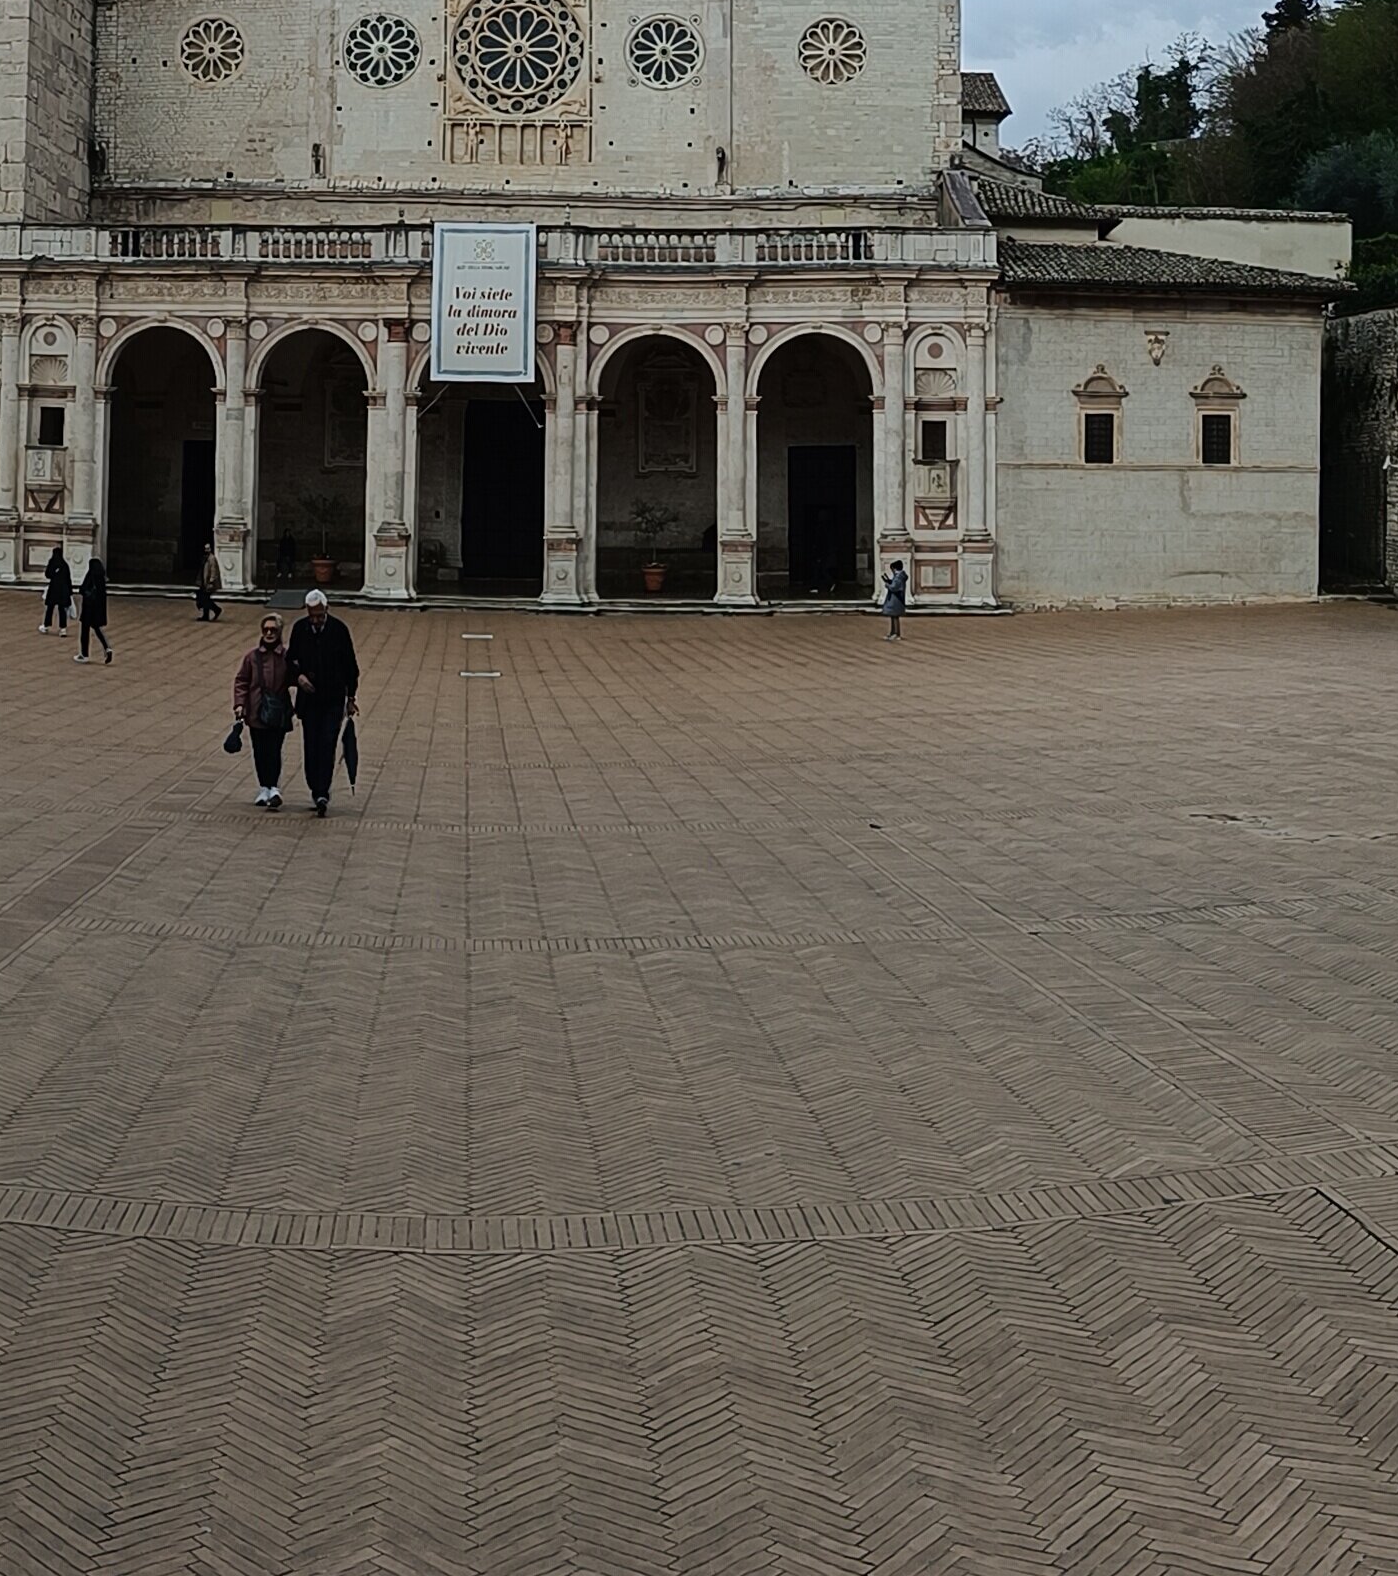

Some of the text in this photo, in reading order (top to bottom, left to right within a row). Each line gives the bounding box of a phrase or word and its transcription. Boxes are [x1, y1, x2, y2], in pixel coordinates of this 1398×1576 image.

[455, 286, 513, 301] Voi siete
[448, 304, 517, 319] la dimora
[456, 322, 508, 336] del Dio
[456, 341, 508, 355] vivente
